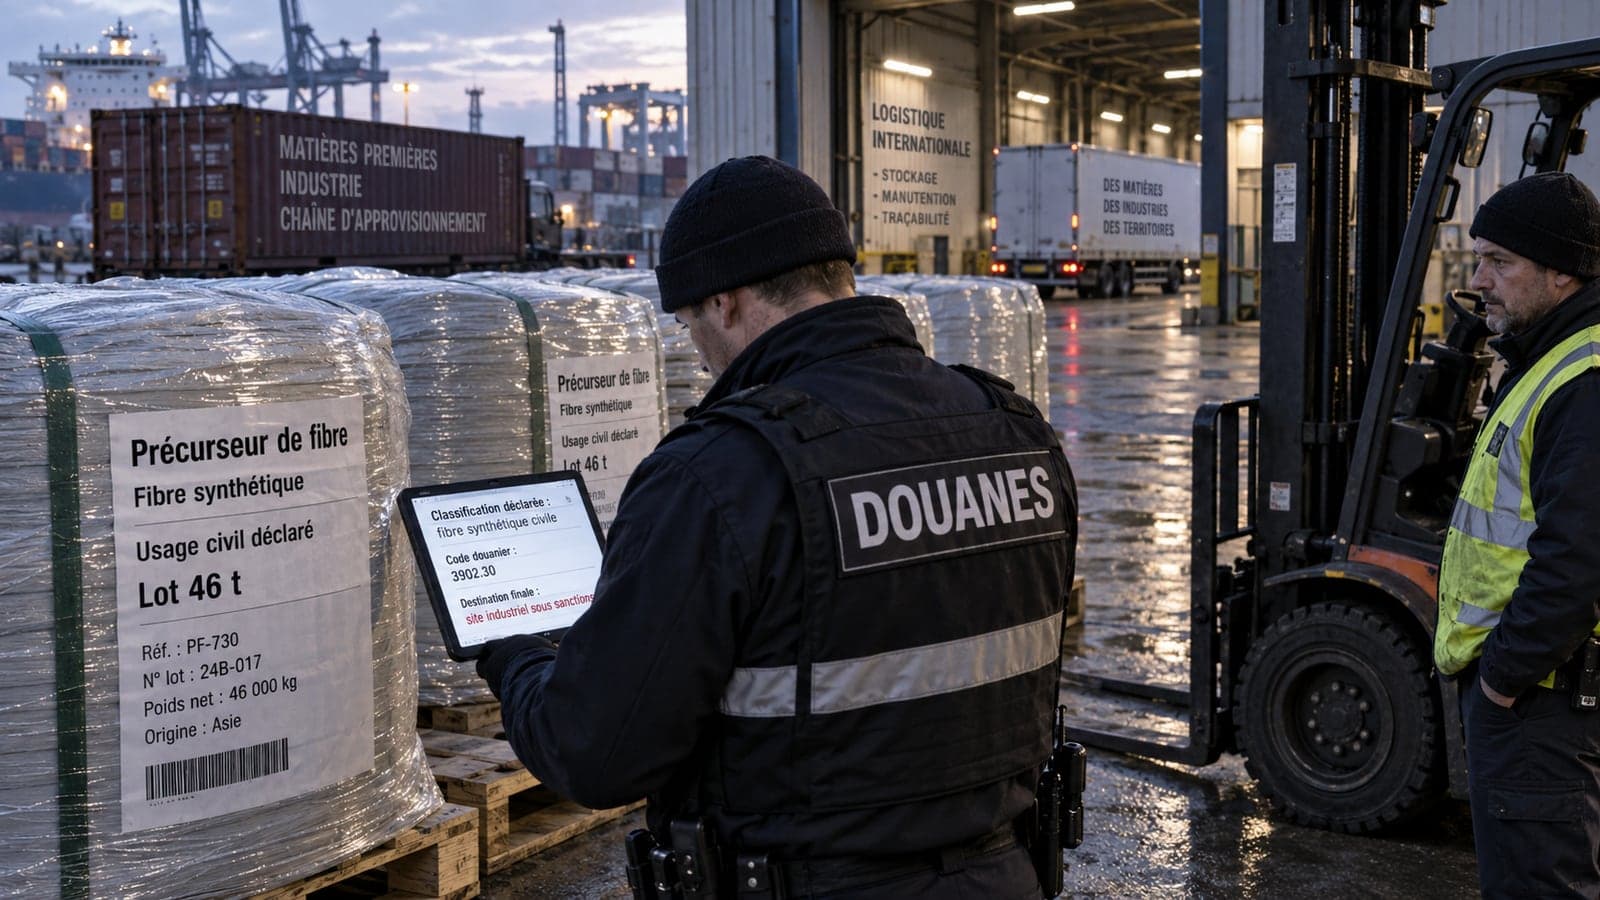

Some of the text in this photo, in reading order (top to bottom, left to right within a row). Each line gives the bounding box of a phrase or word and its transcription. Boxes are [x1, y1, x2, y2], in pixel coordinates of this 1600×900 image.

[872, 101, 945, 131] LOGISTIQUE
[279, 132, 438, 171] MATIÈRES PREMIÈRES
[872, 129, 971, 158] INTERNATIONALE
[280, 170, 363, 198] INDUSTRIE
[881, 168, 938, 185] STOCKAGE
[1103, 177, 1163, 197] DES MATIÈRES
[881, 189, 957, 206] MANUTENTION
[1103, 198, 1169, 217] DES INDUSTRIES
[280, 201, 487, 233] CHAÎNE D'APPROVISIONNEMENT
[881, 210, 950, 228] TRAÇABILITÉ
[1103, 220, 1175, 237] DES TERRITOIRES
[558, 367, 650, 393] Précurseur de fibre
[560, 399, 632, 417] Fibre synthétique
[131, 422, 348, 467] Précurseur de fibre
[561, 434, 589, 449] Usage
[591, 431, 609, 445] civil
[584, 455, 599, 472] 46
[601, 455, 607, 470] t
[134, 474, 304, 508] Fibre synthétique
[431, 502, 500, 522] Classification
[503, 496, 545, 512] déclarée
[850, 465, 1055, 550] DOUANES
[436, 512, 558, 539] fibre synthétique civile
[136, 519, 314, 562] Usage civil déclaré
[446, 553, 470, 566] Code
[473, 546, 511, 561] douanier
[451, 564, 497, 582] 3902.30
[138, 570, 242, 609] Lot 46 t
[460, 593, 509, 609] Destination
[510, 587, 535, 600] finale
[466, 613, 484, 625] site
[486, 603, 529, 621] industriel
[531, 602, 553, 614] sous
[142, 641, 172, 661] Réf.
[186, 631, 239, 655] PF-730
[143, 670, 161, 689] N°
[166, 668, 185, 686] lot
[200, 654, 262, 680] 24B-017
[144, 698, 185, 717] Poids
[190, 692, 214, 709] net
[229, 684, 247, 701] 46
[252, 678, 278, 696] 000
[282, 675, 297, 693] kg
[145, 724, 197, 745] Origine
[212, 714, 242, 733] Asie
